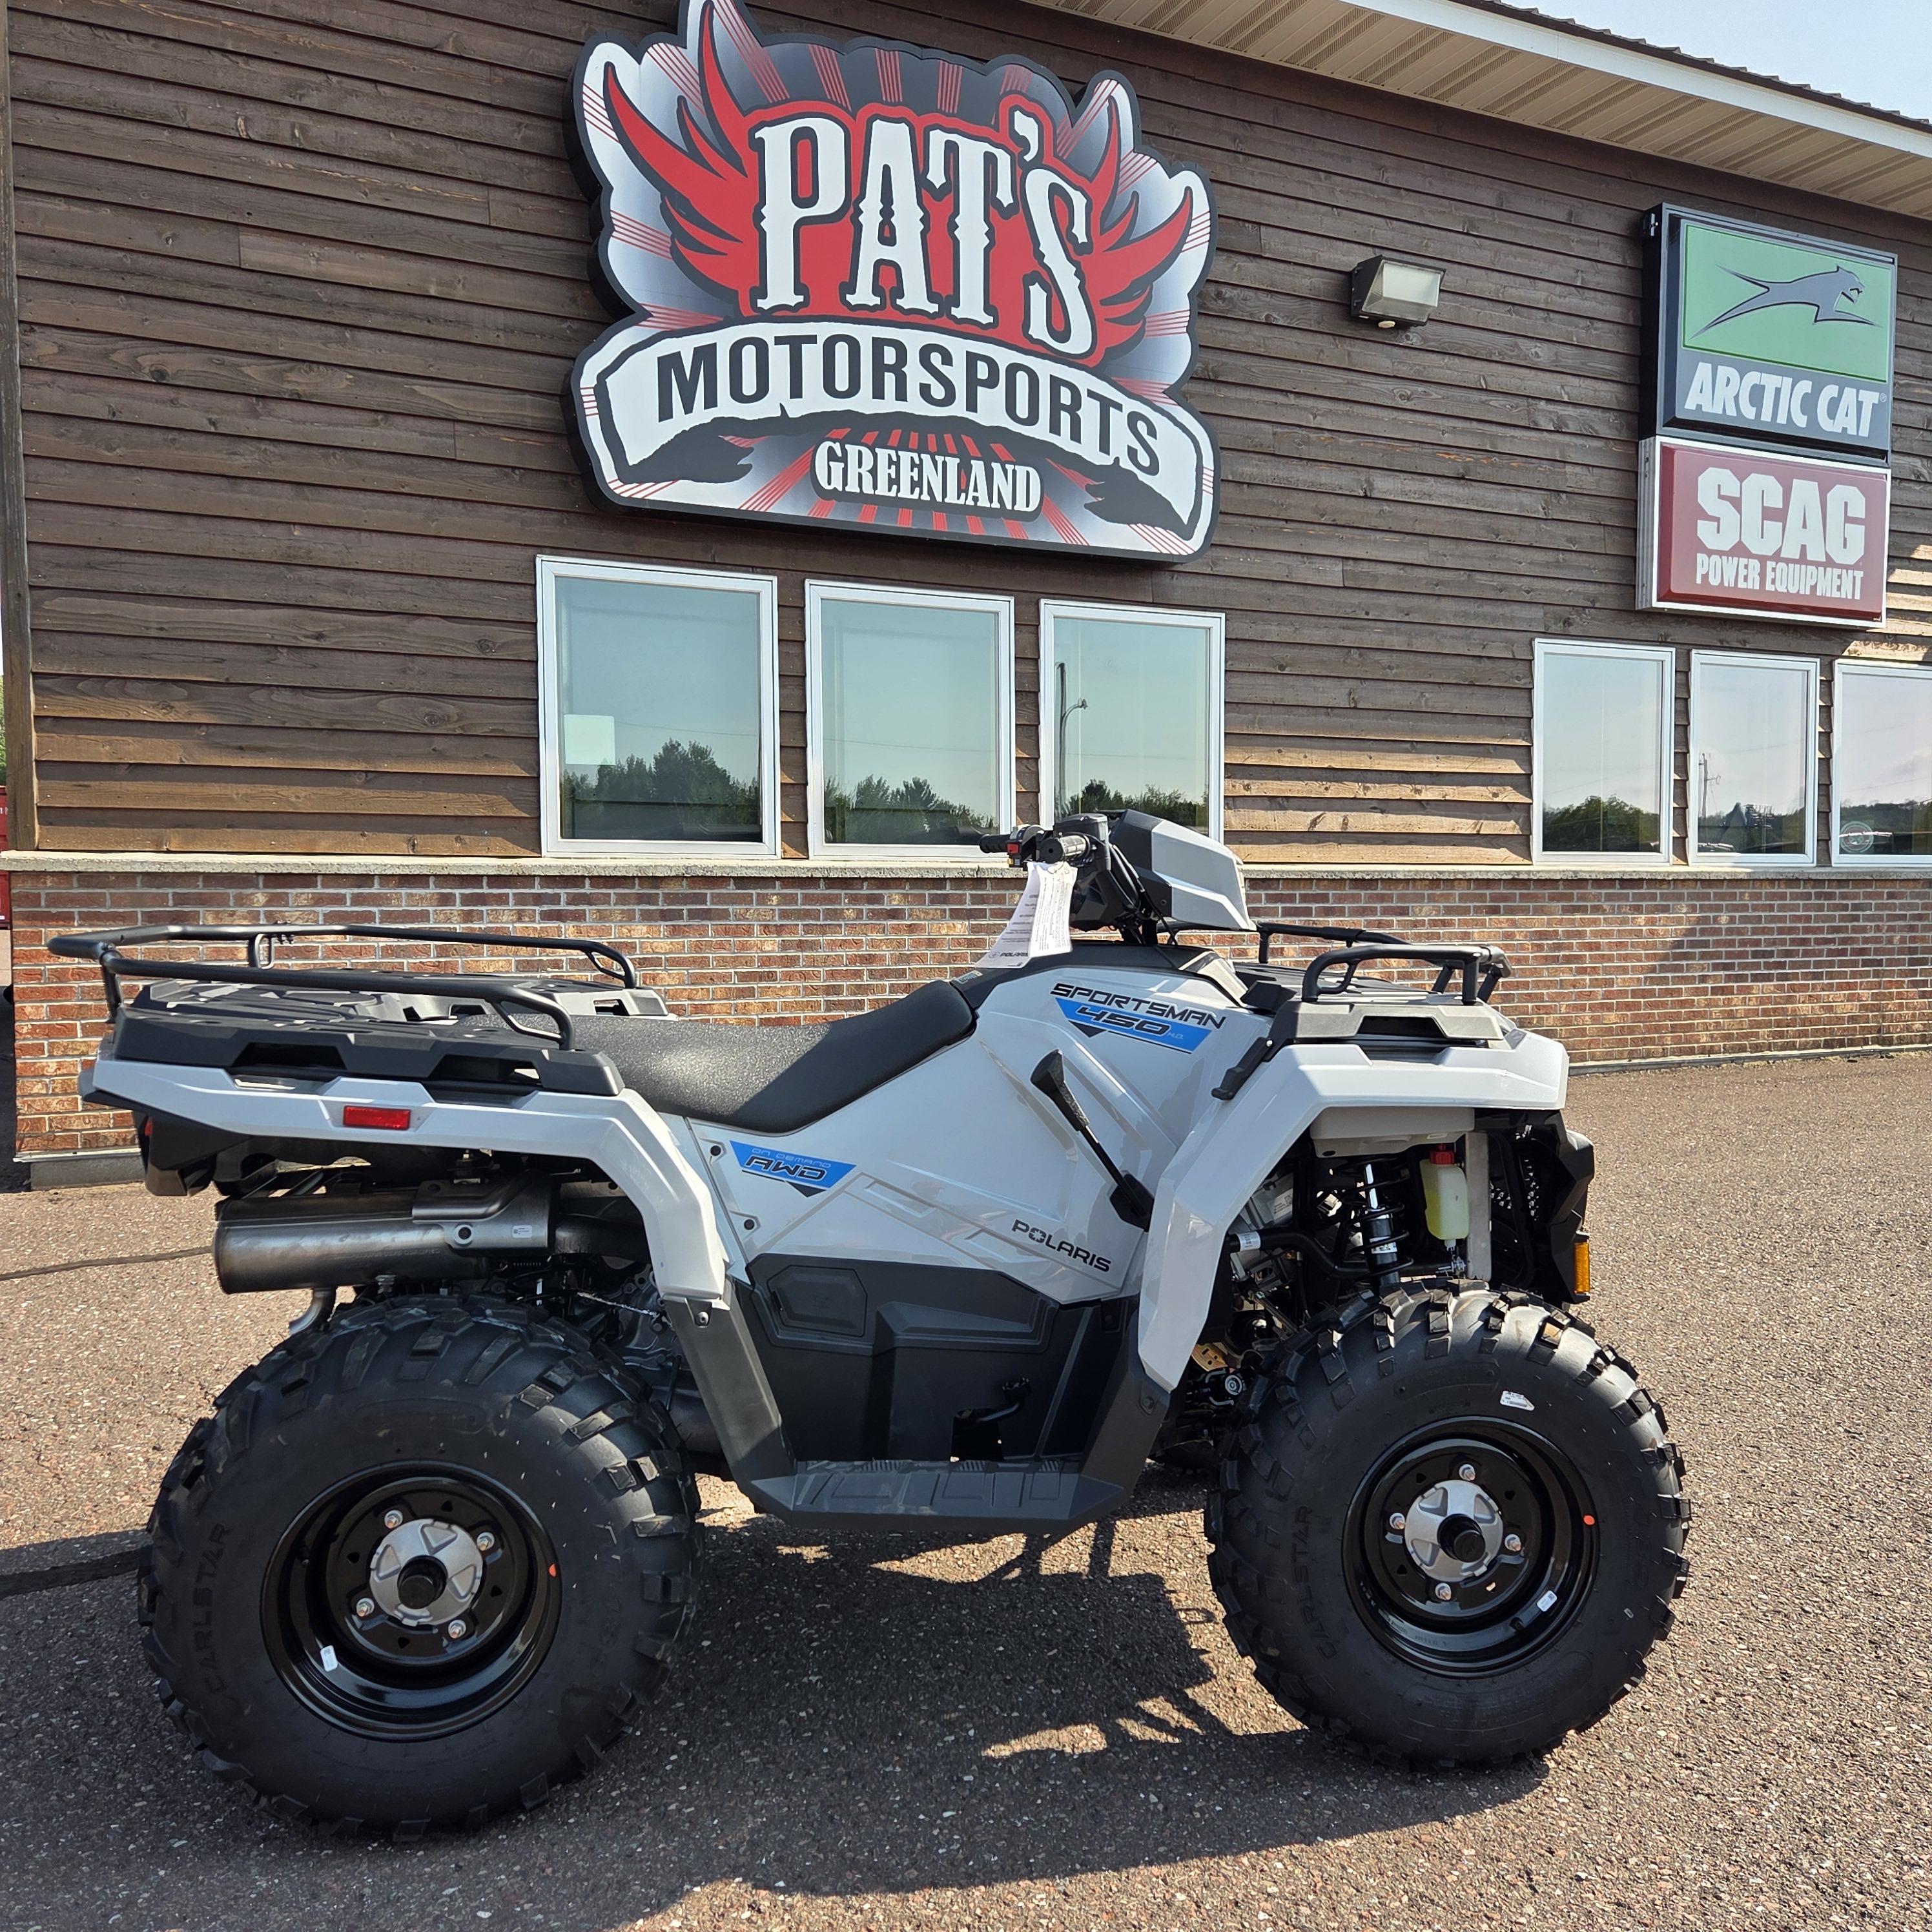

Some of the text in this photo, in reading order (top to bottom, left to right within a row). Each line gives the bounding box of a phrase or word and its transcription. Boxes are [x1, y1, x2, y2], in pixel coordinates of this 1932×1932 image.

[755, 109, 1092, 356] PAT'S
[657, 333, 1160, 477] MOTORSPORTS
[1683, 362, 1880, 438] ARCTIC CAT
[815, 441, 1040, 513] GREENLAND
[1697, 466, 1865, 565] SCAG
[1696, 553, 1864, 600] POWER EQUIPMENT
[1050, 982, 1227, 1029] SPORTSMAN
[1077, 1007, 1170, 1036] 450
[745, 1155, 826, 1180] AWD
[1011, 1219, 1111, 1272] POLARIS
[192, 1523, 234, 1695] CARLSTAR
[1291, 1505, 1338, 1660] CARLSTAR
